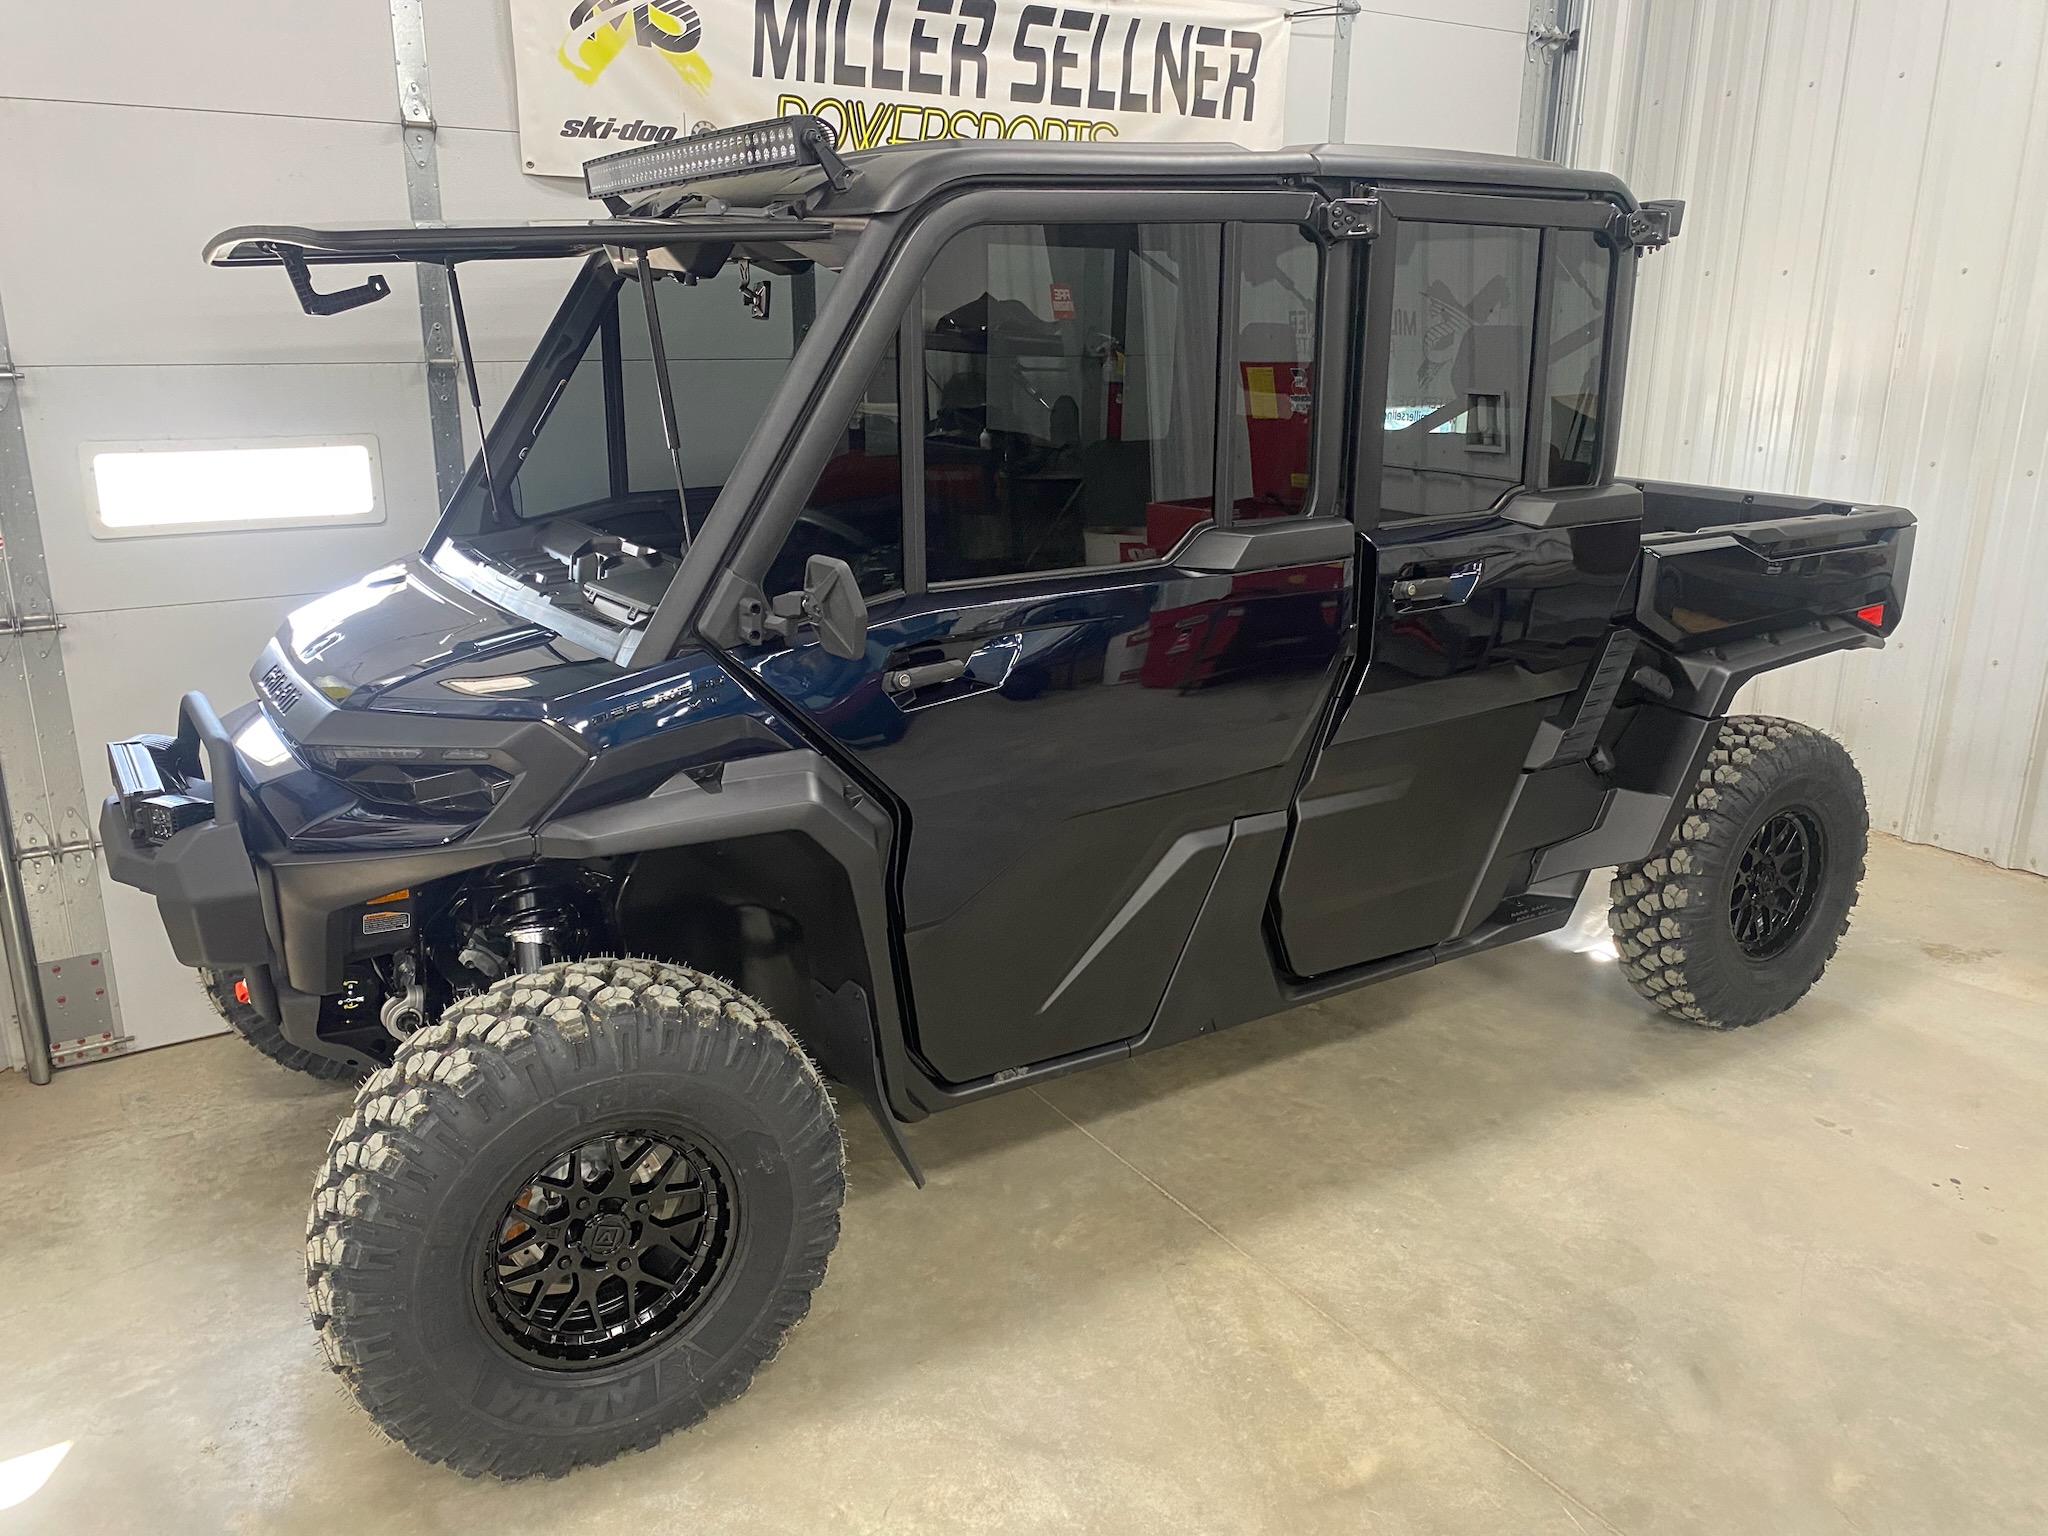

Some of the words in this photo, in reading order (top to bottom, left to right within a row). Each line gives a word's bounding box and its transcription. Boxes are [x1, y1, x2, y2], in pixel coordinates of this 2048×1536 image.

[752, 0, 997, 98] MILLER
[1010, 4, 1263, 122] SELLNER
[559, 116, 679, 142] ski-doo
